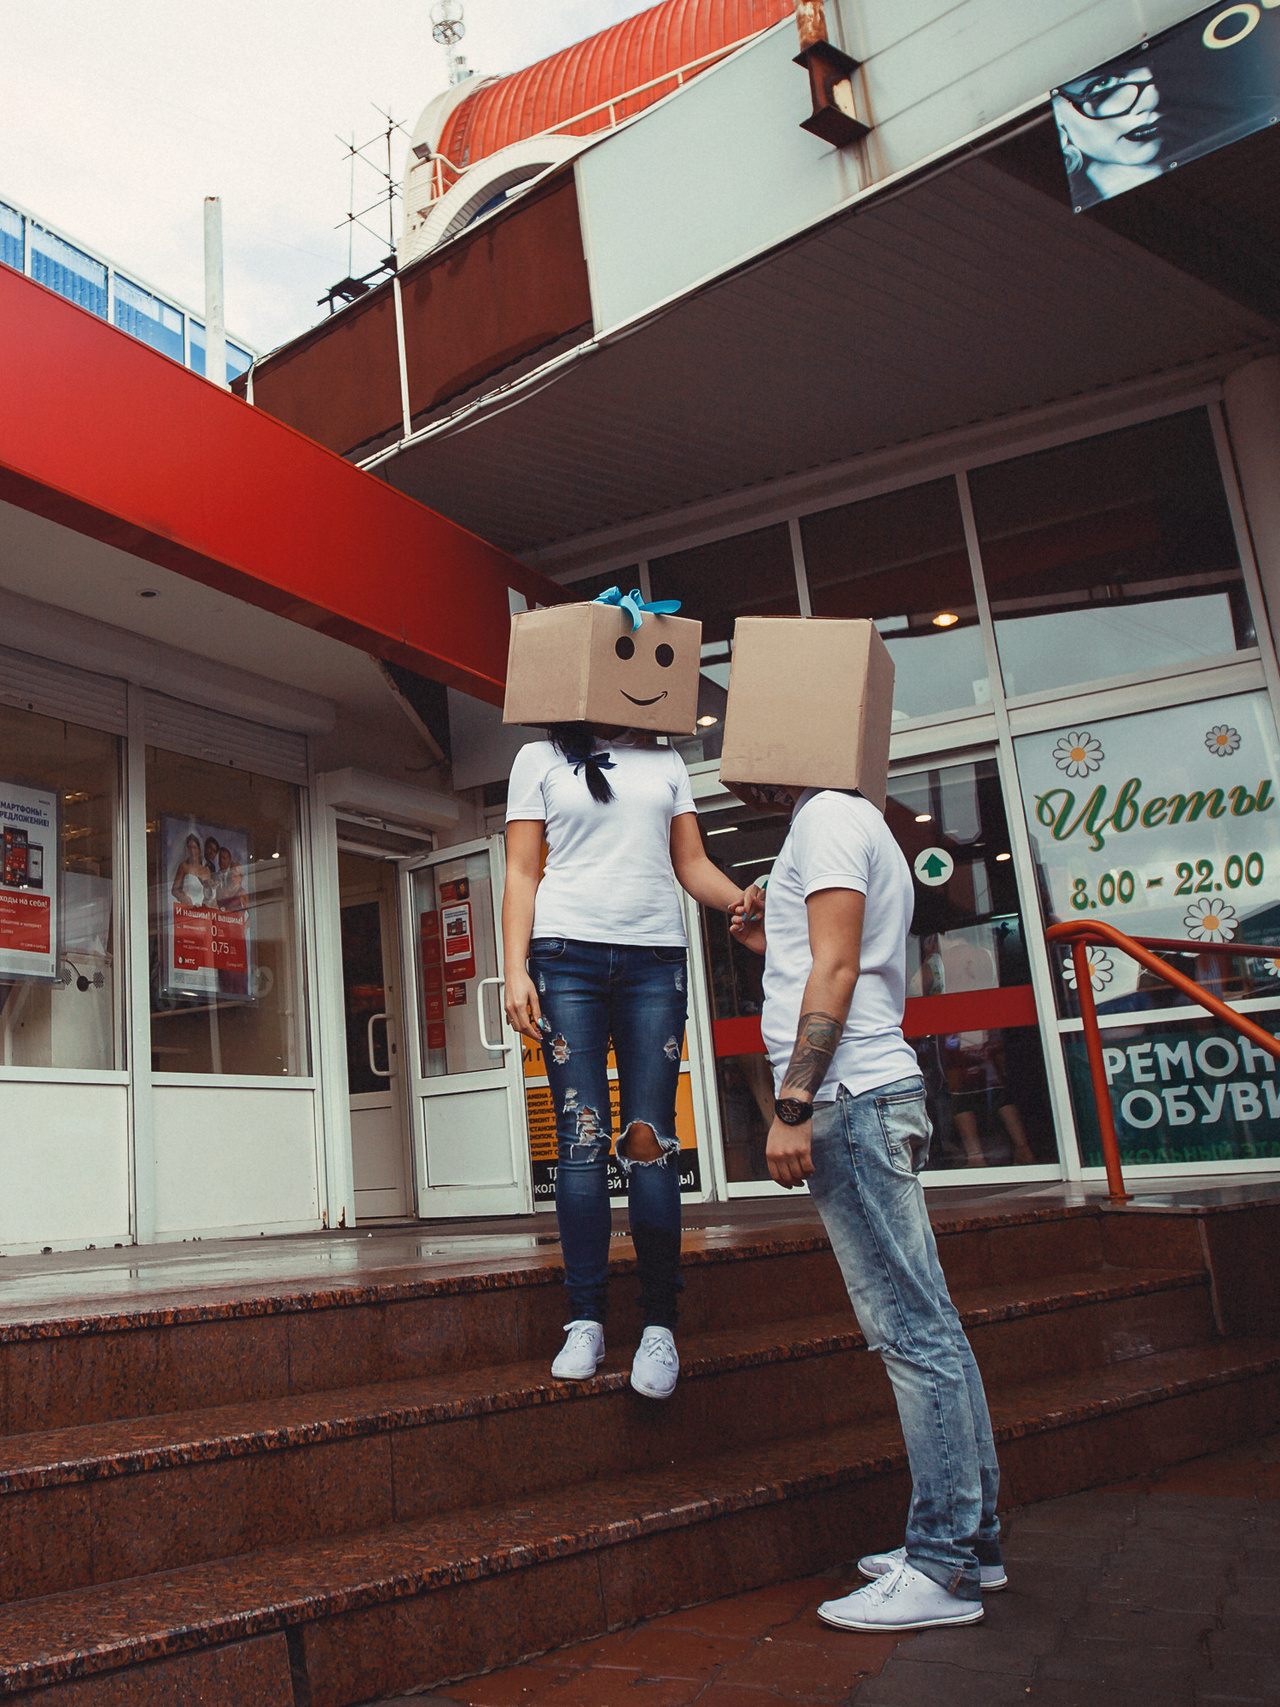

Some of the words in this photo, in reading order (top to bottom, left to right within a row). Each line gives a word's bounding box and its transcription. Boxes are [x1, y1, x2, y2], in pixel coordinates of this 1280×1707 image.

[1202, 0, 1280, 50] О
[1033, 777, 1275, 852] Цветы
[1070, 869, 1136, 911] 8.00
[1174, 851, 1265, 896] 22.00
[29, 899, 48, 908] себя!
[175, 907, 182, 915] И
[183, 911, 211, 920] нашим!
[211, 913, 217, 921] И
[211, 925, 218, 937] 0
[211, 940, 230, 955] 0,75
[1101, 1032, 1280, 1086] РЕМОН
